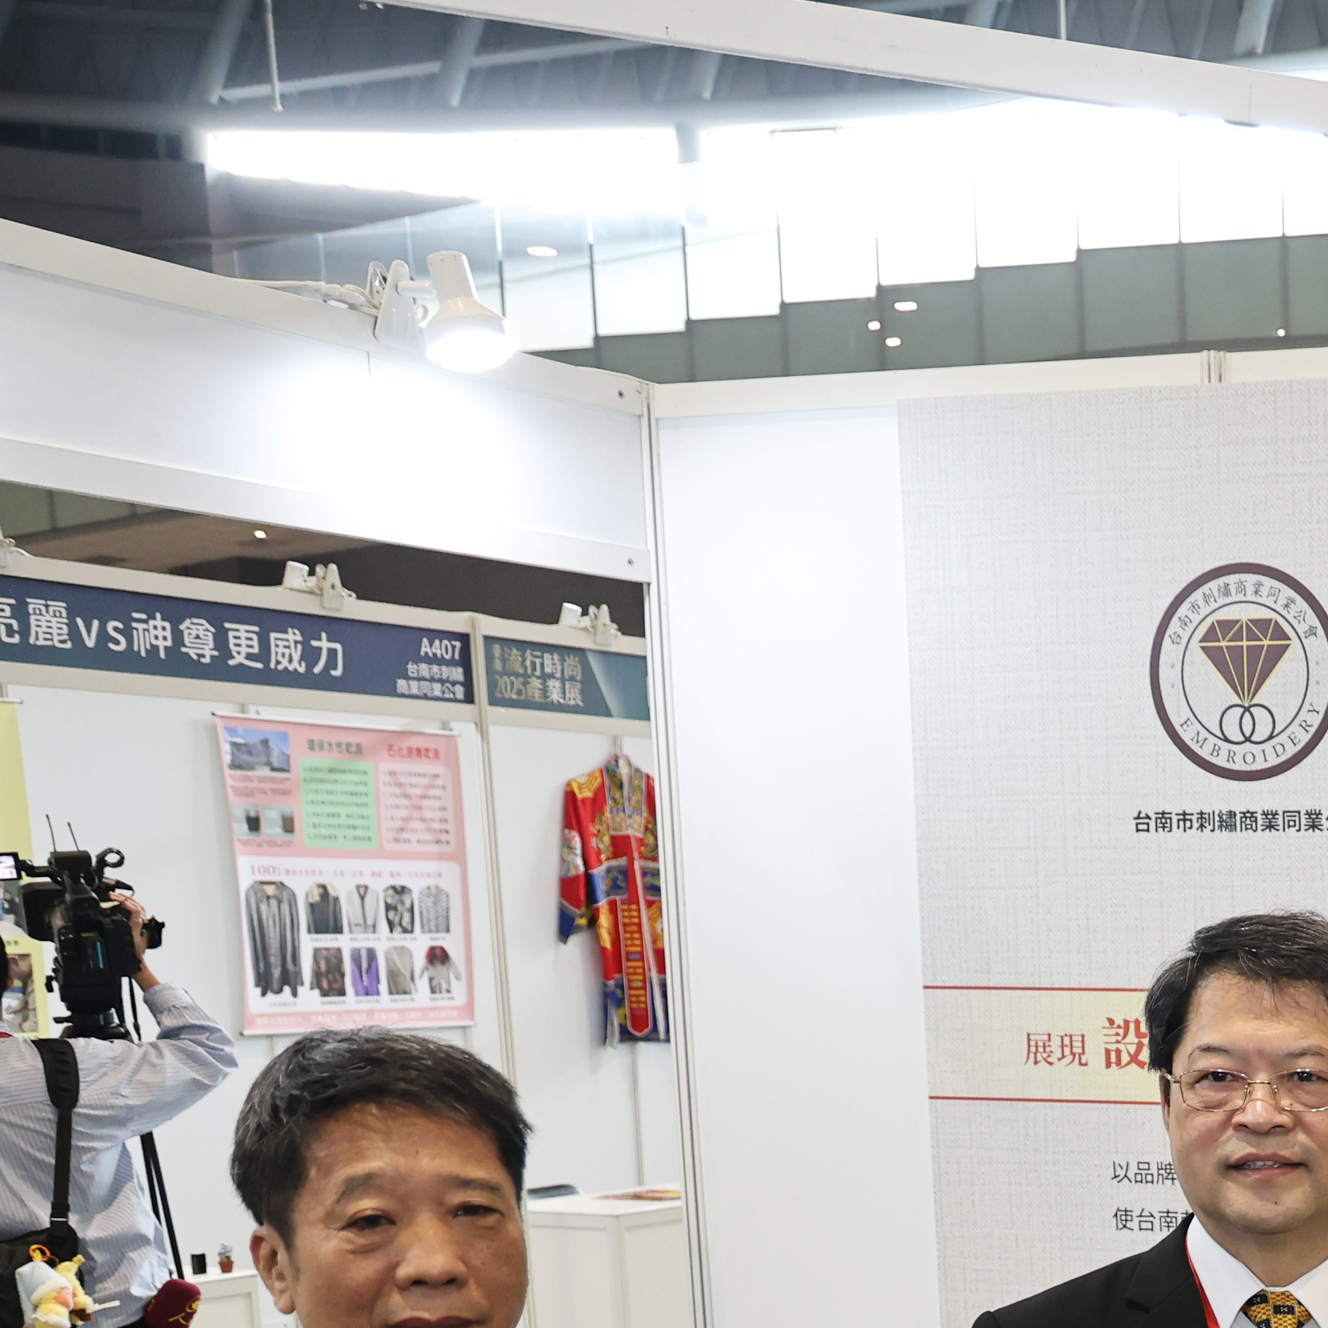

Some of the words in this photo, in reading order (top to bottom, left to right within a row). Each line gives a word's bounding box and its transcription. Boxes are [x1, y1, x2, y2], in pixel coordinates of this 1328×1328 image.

[420, 637, 461, 660] A407
[1180, 702, 1321, 765] EMBROIDERY
[1024, 1031, 1088, 1068] 展現
